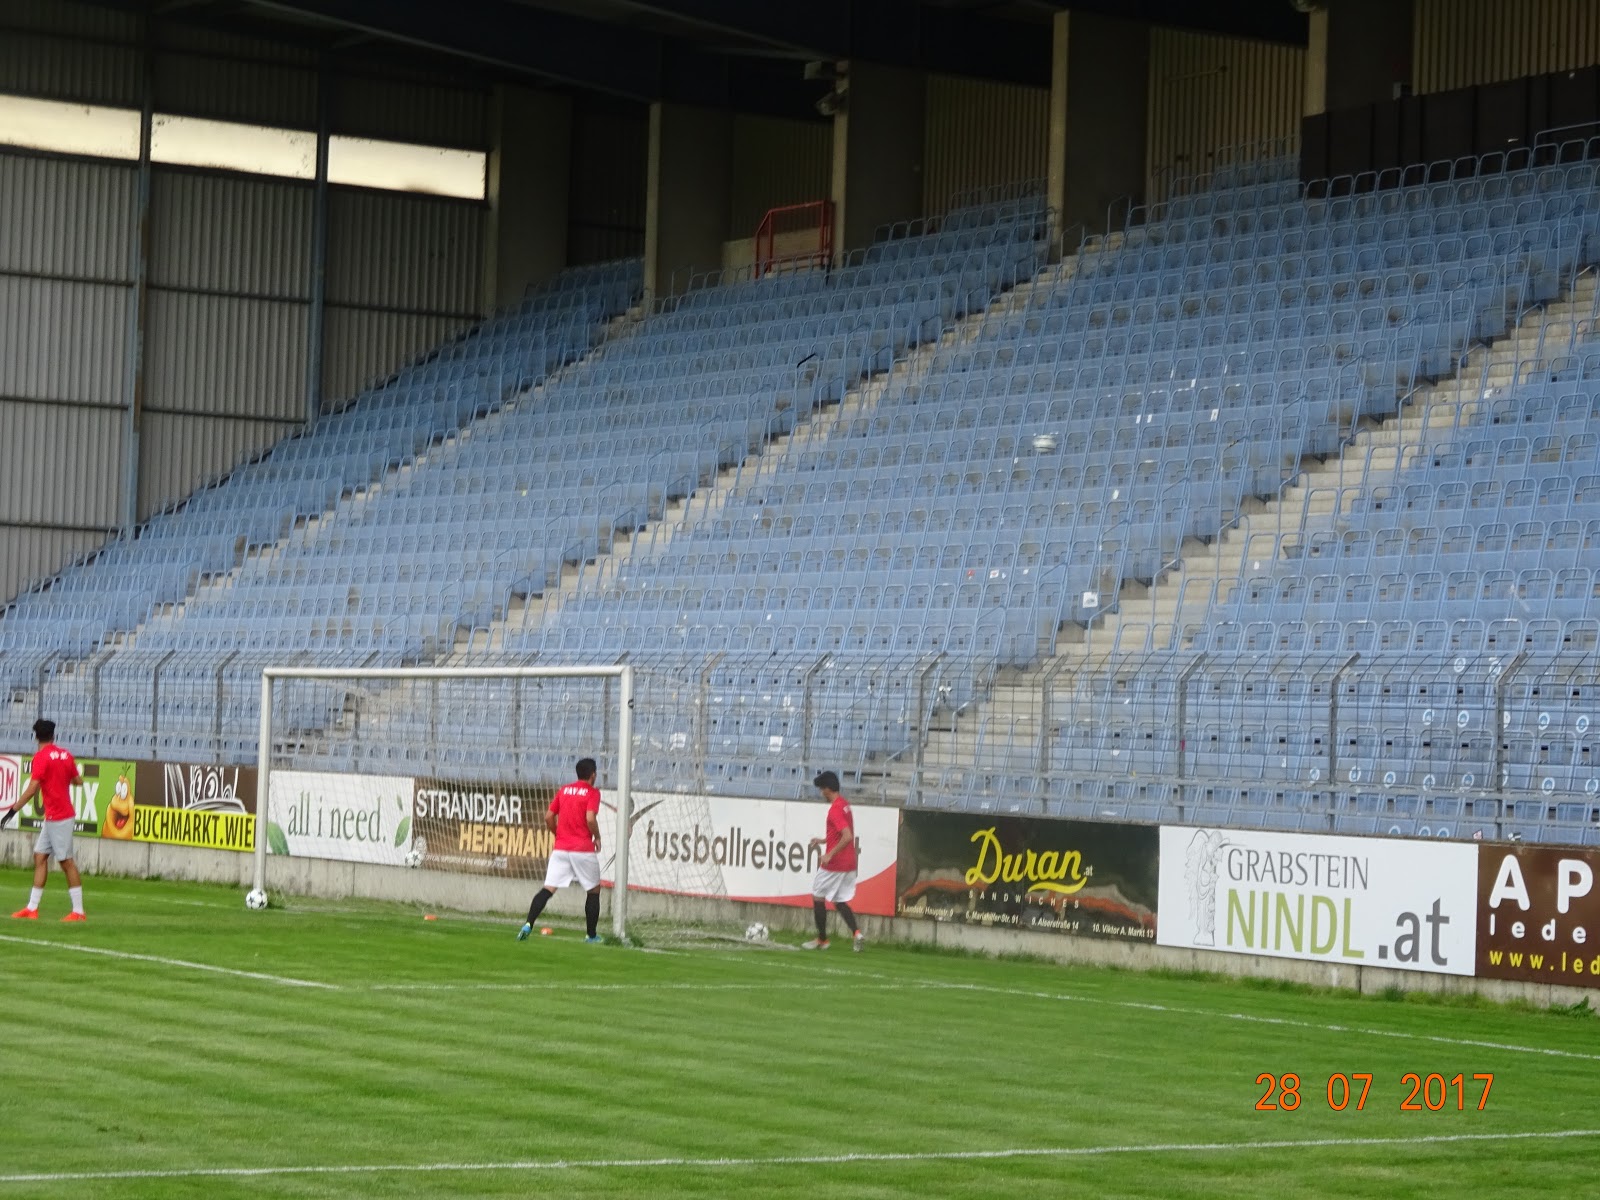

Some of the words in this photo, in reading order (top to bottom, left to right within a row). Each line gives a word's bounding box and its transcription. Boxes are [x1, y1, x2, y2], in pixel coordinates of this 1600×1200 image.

[288, 789, 310, 837] all
[316, 795, 323, 837] i
[329, 794, 387, 843] need.
[416, 788, 522, 825] STRANDBAR
[965, 826, 1083, 886] Duran
[1227, 848, 1369, 890] GRABSTEIN
[968, 889, 1080, 910] SANDWICHES
[1226, 888, 1365, 959] NINDL
[1378, 897, 1450, 967] .at
